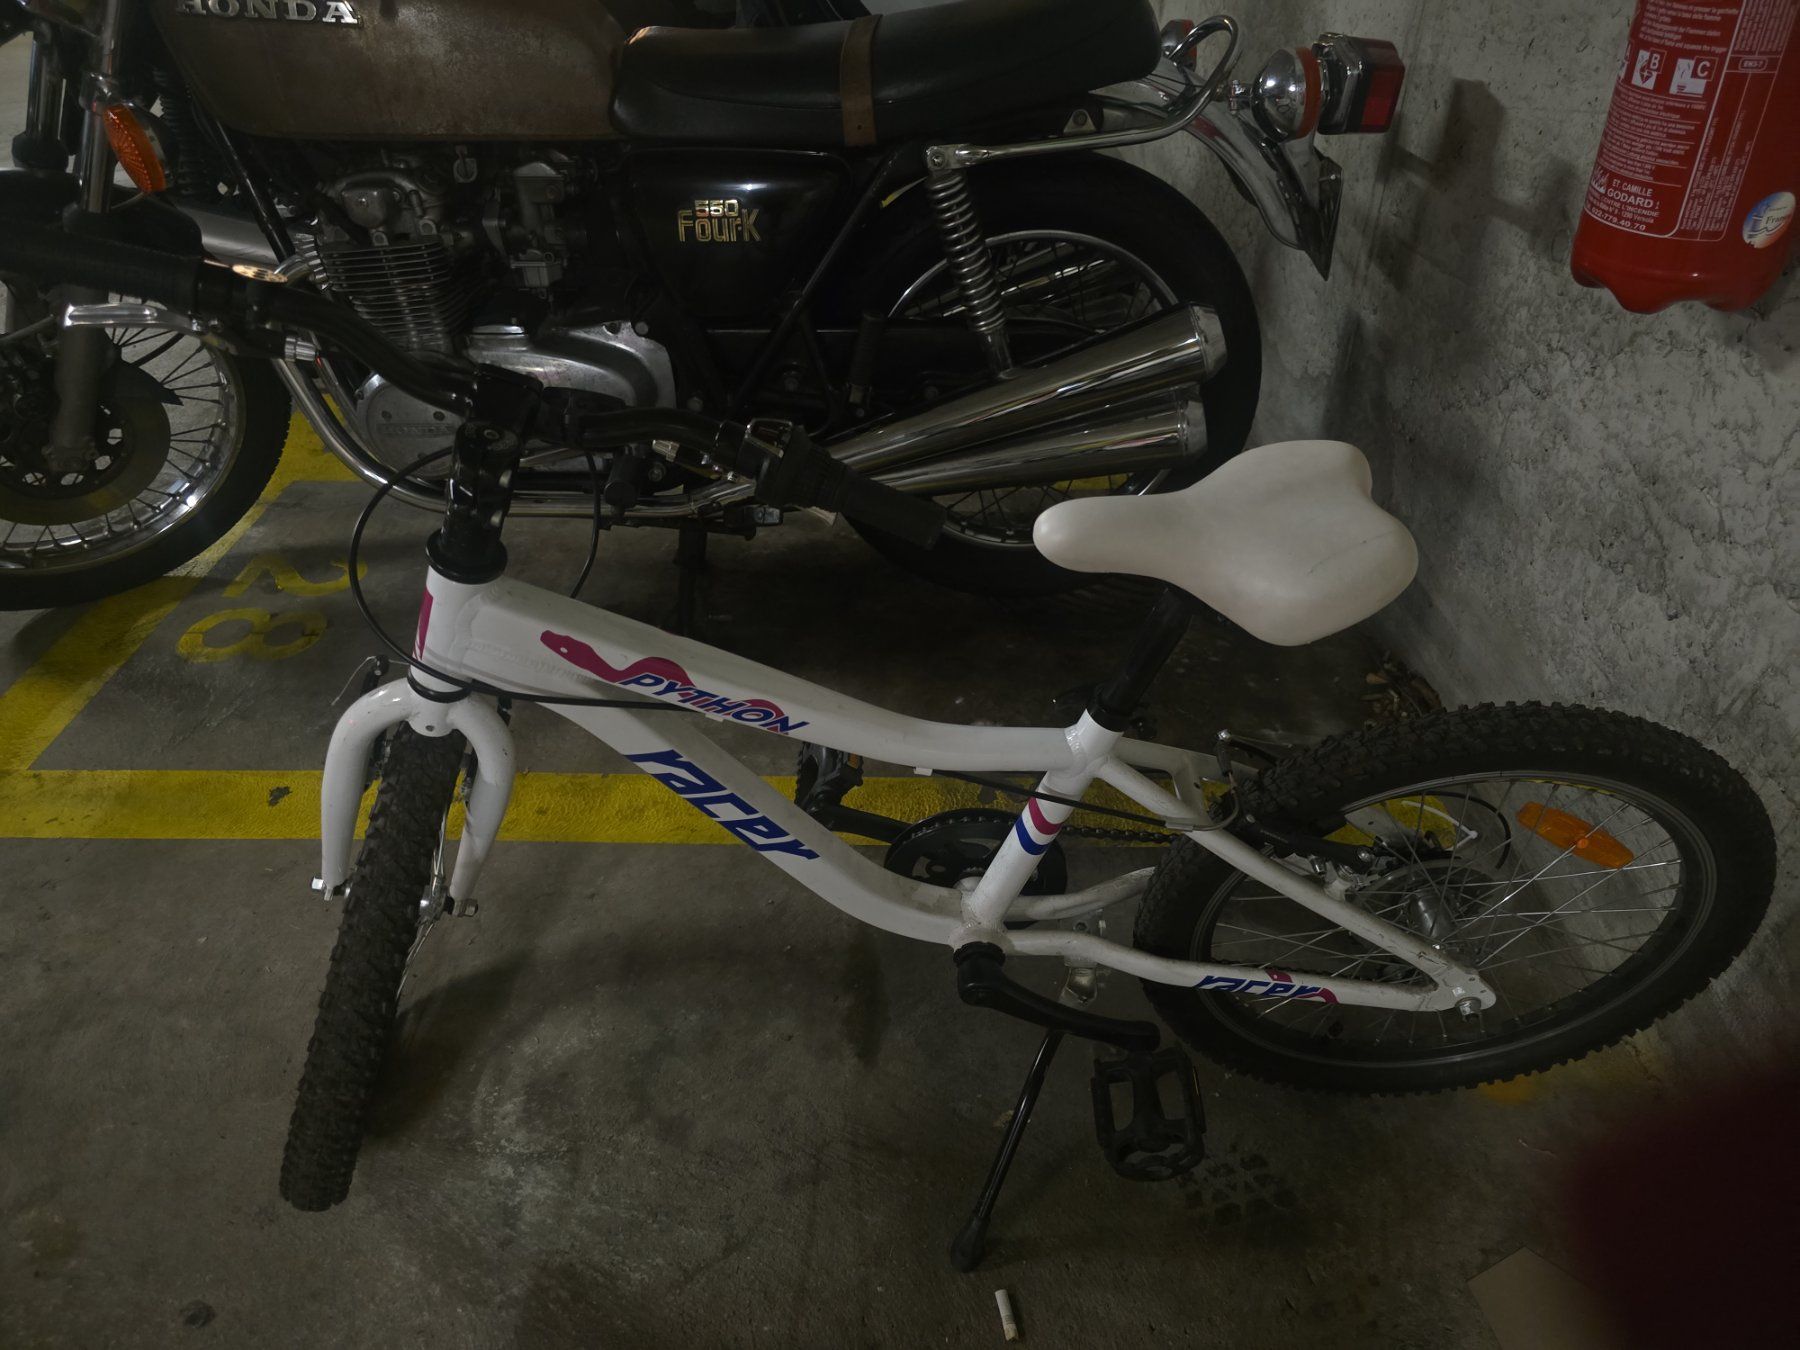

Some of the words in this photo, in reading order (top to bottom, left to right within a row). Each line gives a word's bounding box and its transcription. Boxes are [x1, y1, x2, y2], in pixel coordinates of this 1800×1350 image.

[176, 0, 358, 25] HONDA
[1606, 188, 1654, 208] GODARD
[1622, 182, 1654, 196] CAMILLE
[694, 199, 739, 218] 550
[620, 672, 810, 736] PYTHON
[623, 748, 820, 861] racer
[1194, 975, 1322, 999] racer
